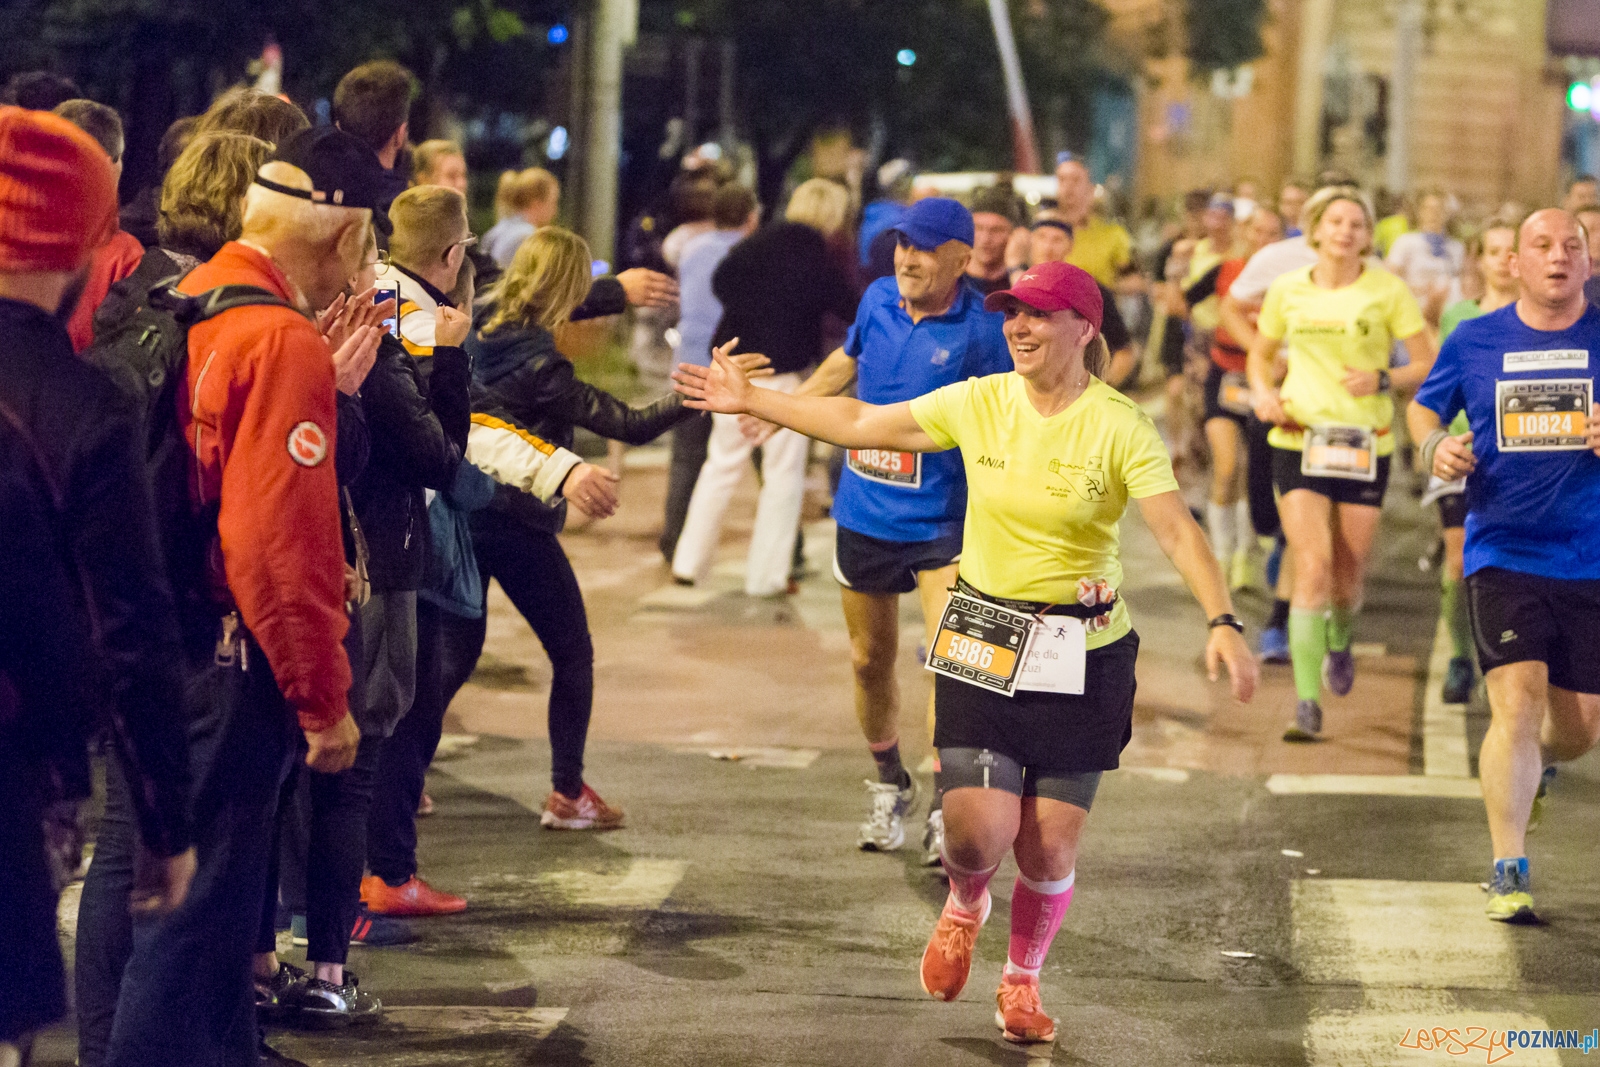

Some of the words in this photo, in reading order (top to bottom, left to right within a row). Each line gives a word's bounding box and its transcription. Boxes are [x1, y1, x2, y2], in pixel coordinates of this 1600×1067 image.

[1548, 351, 1586, 361] POLSKA
[1517, 413, 1573, 435] 10824
[976, 455, 1005, 471] ANIA
[947, 635, 995, 669] 5986
[1043, 649, 1059, 660] dla
